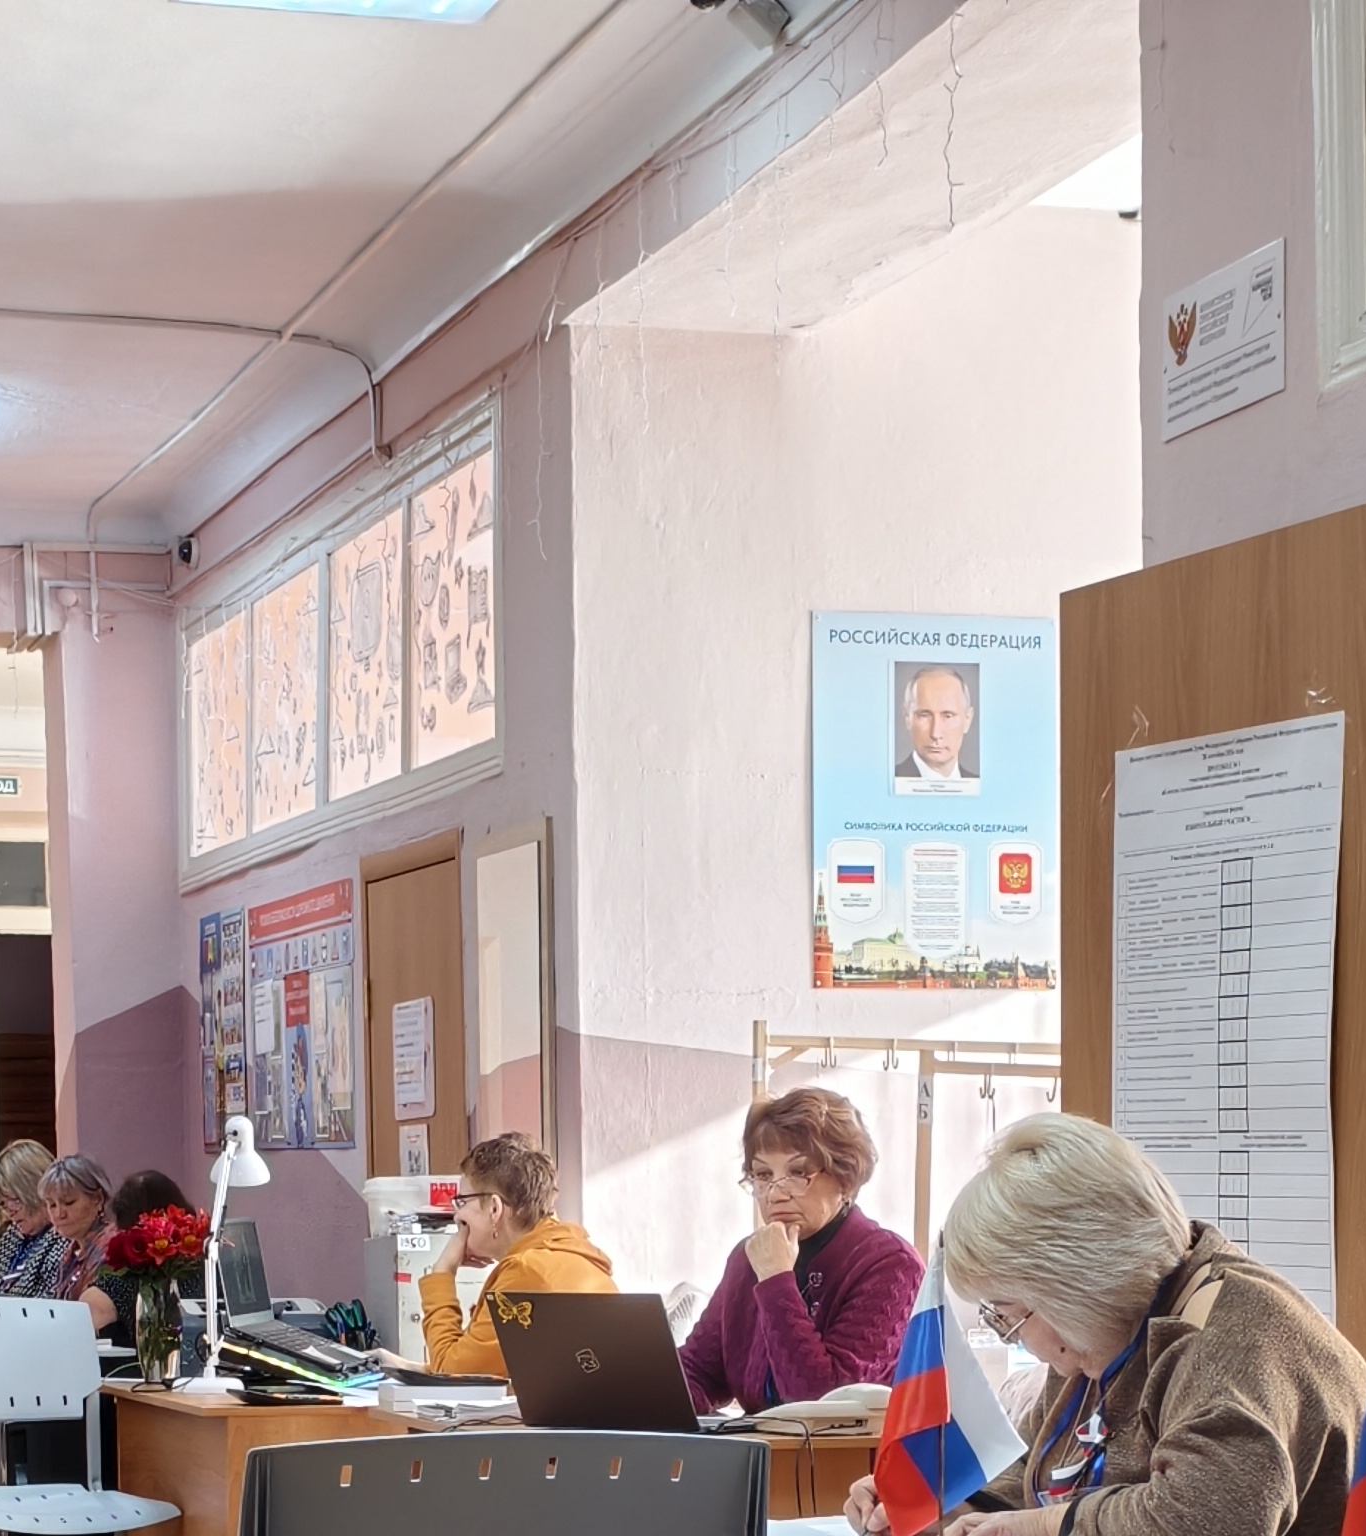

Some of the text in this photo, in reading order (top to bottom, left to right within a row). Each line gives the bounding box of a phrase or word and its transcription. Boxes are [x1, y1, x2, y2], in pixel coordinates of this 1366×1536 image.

[829, 628, 1042, 651] РОССИЙСКАЯ ФЕДЕРАЦИЯ
[844, 821, 1028, 834] СИМВОЛИКА РОССИЙСКОЙ ФЕДЕРАЦИИ
